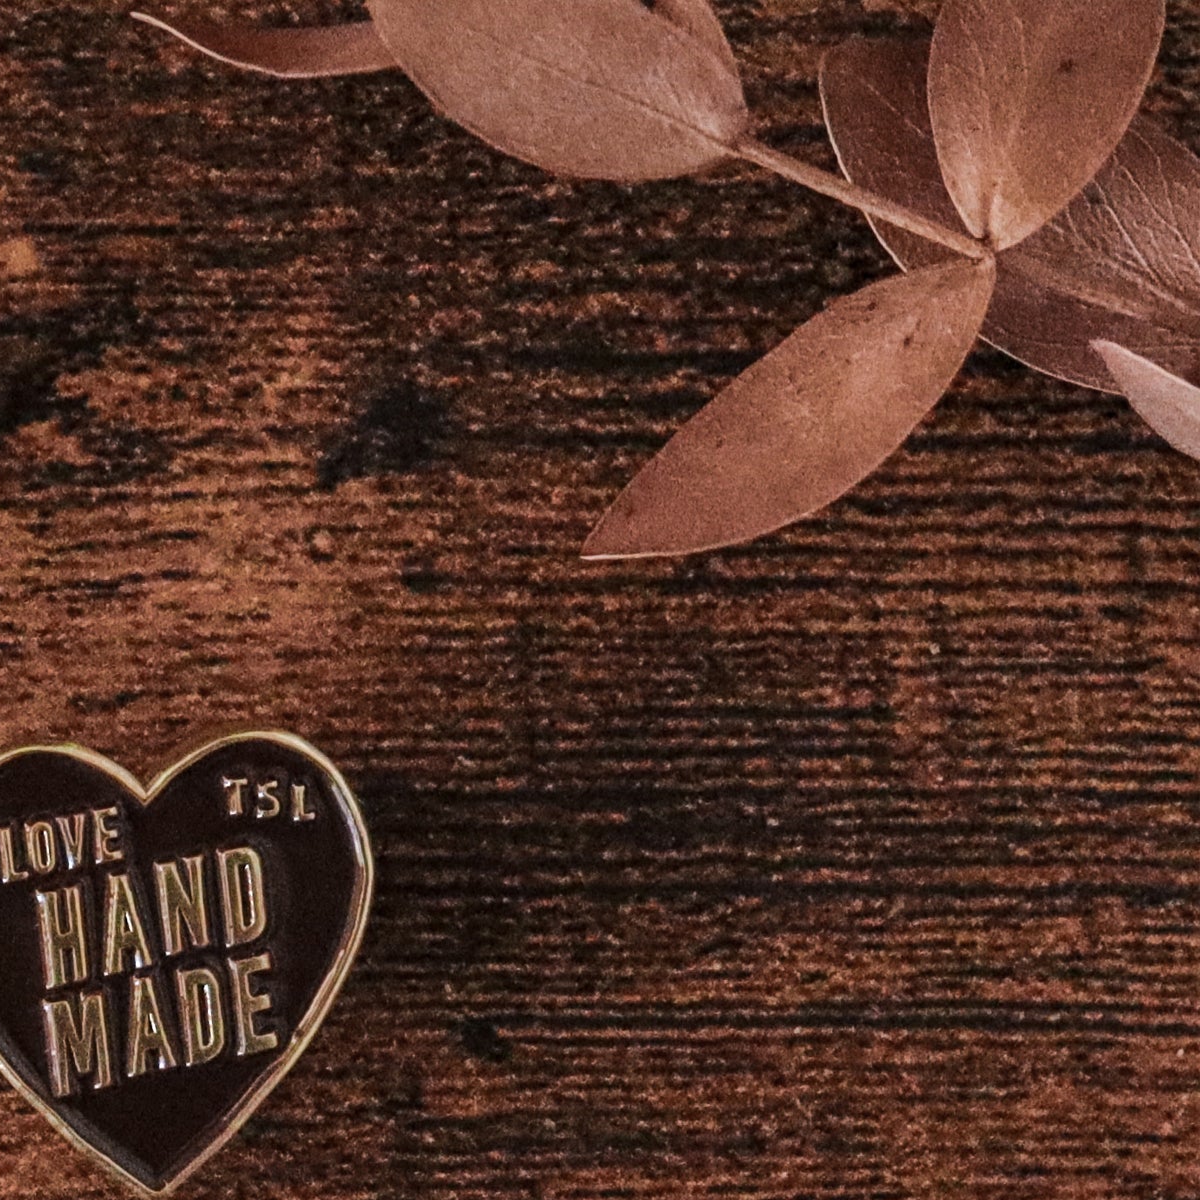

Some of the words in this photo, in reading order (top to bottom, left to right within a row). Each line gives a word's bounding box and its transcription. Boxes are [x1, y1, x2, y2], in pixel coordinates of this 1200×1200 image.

[222, 775, 316, 821] TSL
[35, 846, 267, 989] HAND
[43, 952, 278, 1097] MADE
